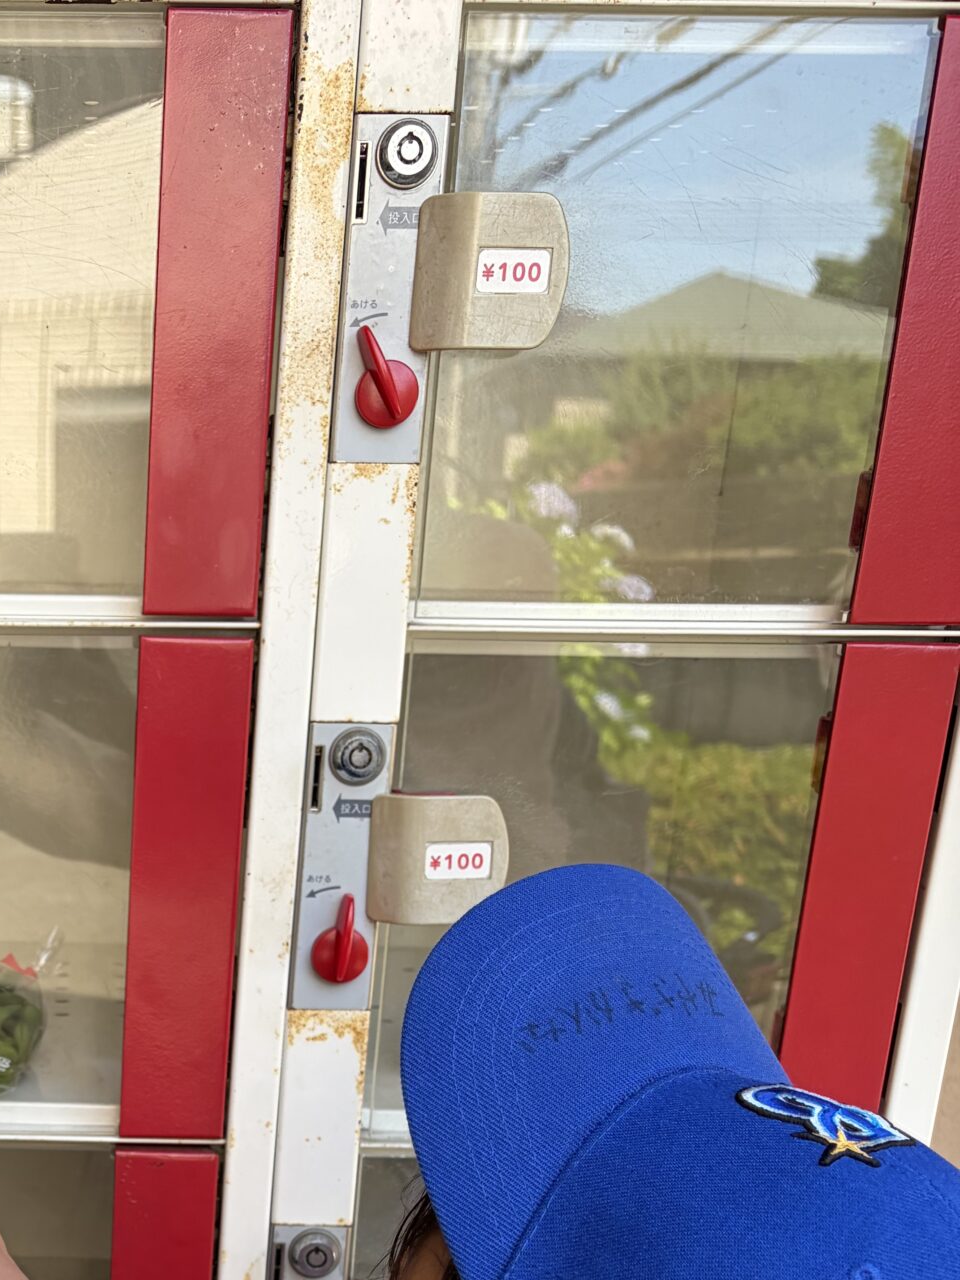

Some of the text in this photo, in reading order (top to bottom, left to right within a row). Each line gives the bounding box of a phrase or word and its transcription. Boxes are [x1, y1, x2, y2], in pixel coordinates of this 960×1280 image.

[482, 262, 542, 282] ¥100
[350, 298, 378, 309] あける
[340, 803, 371, 814] 投入口
[430, 853, 484, 871] ¥100
